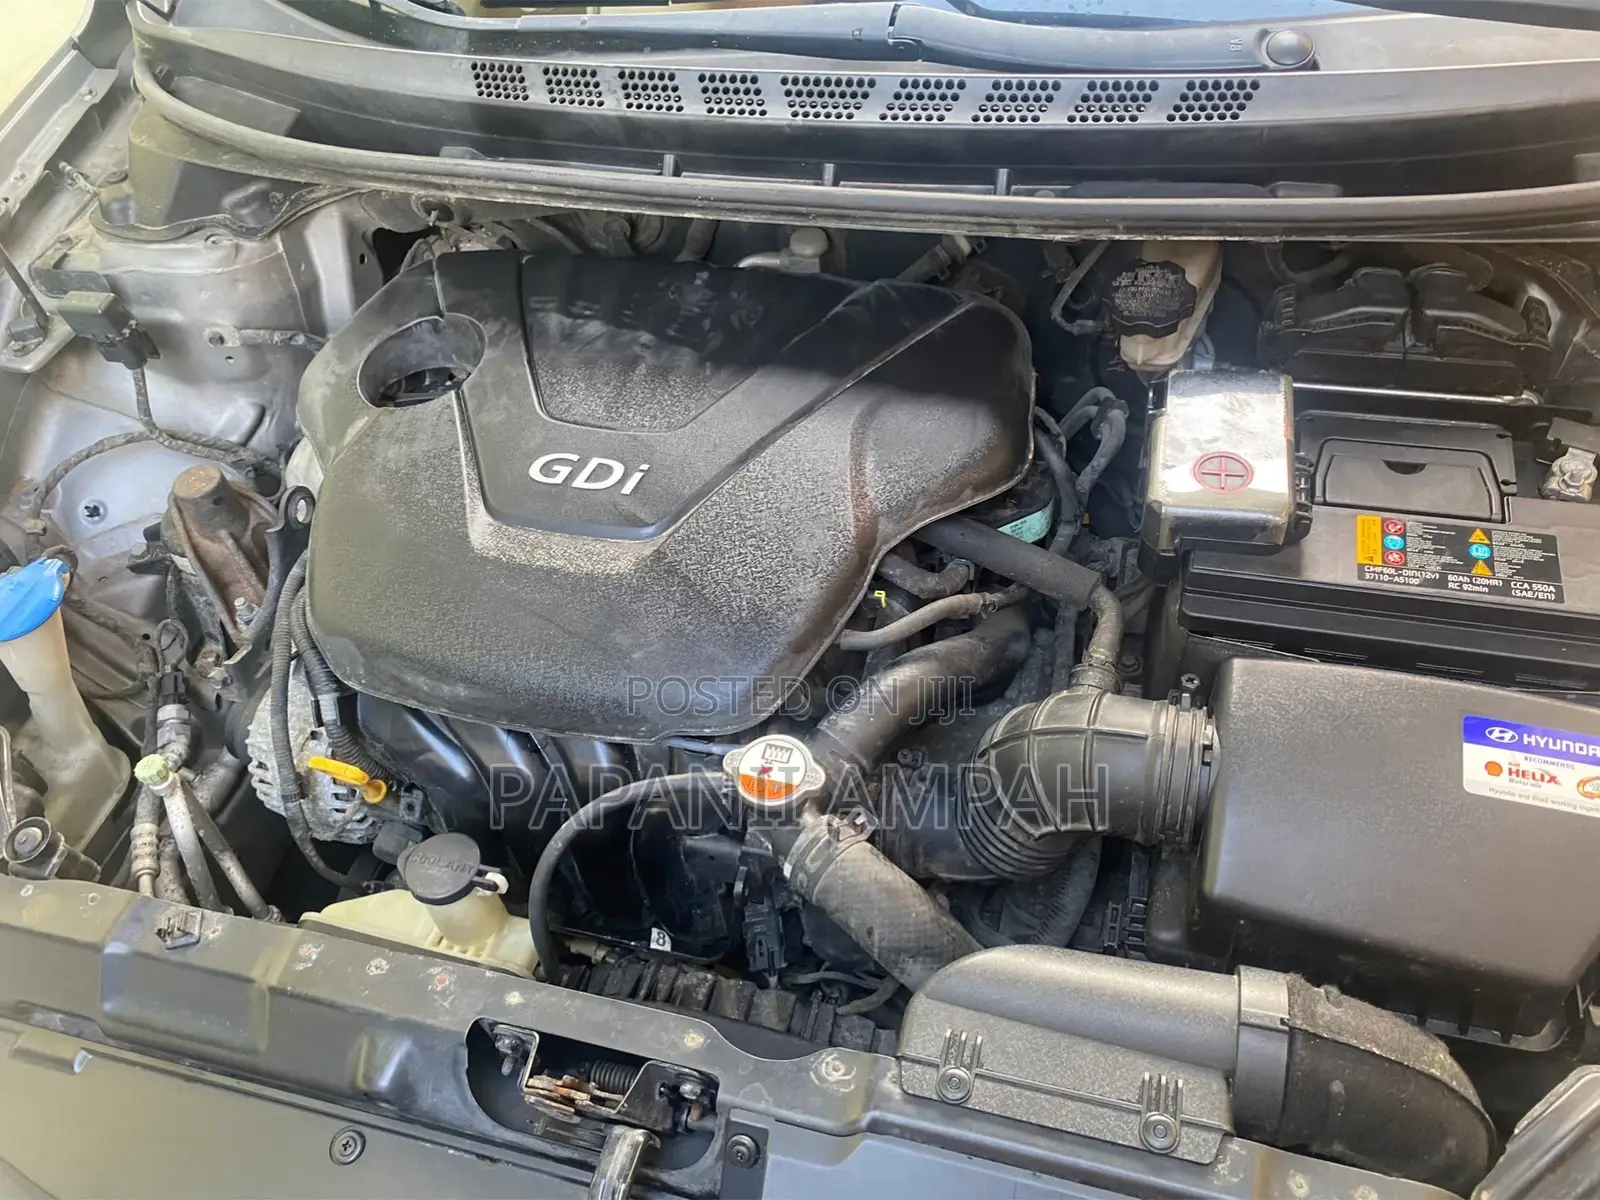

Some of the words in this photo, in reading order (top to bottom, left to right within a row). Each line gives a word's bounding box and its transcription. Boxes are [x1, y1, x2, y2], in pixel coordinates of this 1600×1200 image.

[528, 452, 650, 496] GDi
[1364, 573, 1420, 585] 37110-A5100
[1447, 574, 1470, 583] 60Ah
[1472, 576, 1503, 587] (20HR)
[1462, 583, 1489, 593] 92min
[1511, 581, 1530, 590] CCA
[1532, 583, 1556, 593] 550A
[1524, 756, 1575, 770] RECOMMENDS
[1508, 767, 1561, 786] HELIX
[410, 851, 476, 875] COOLANT
